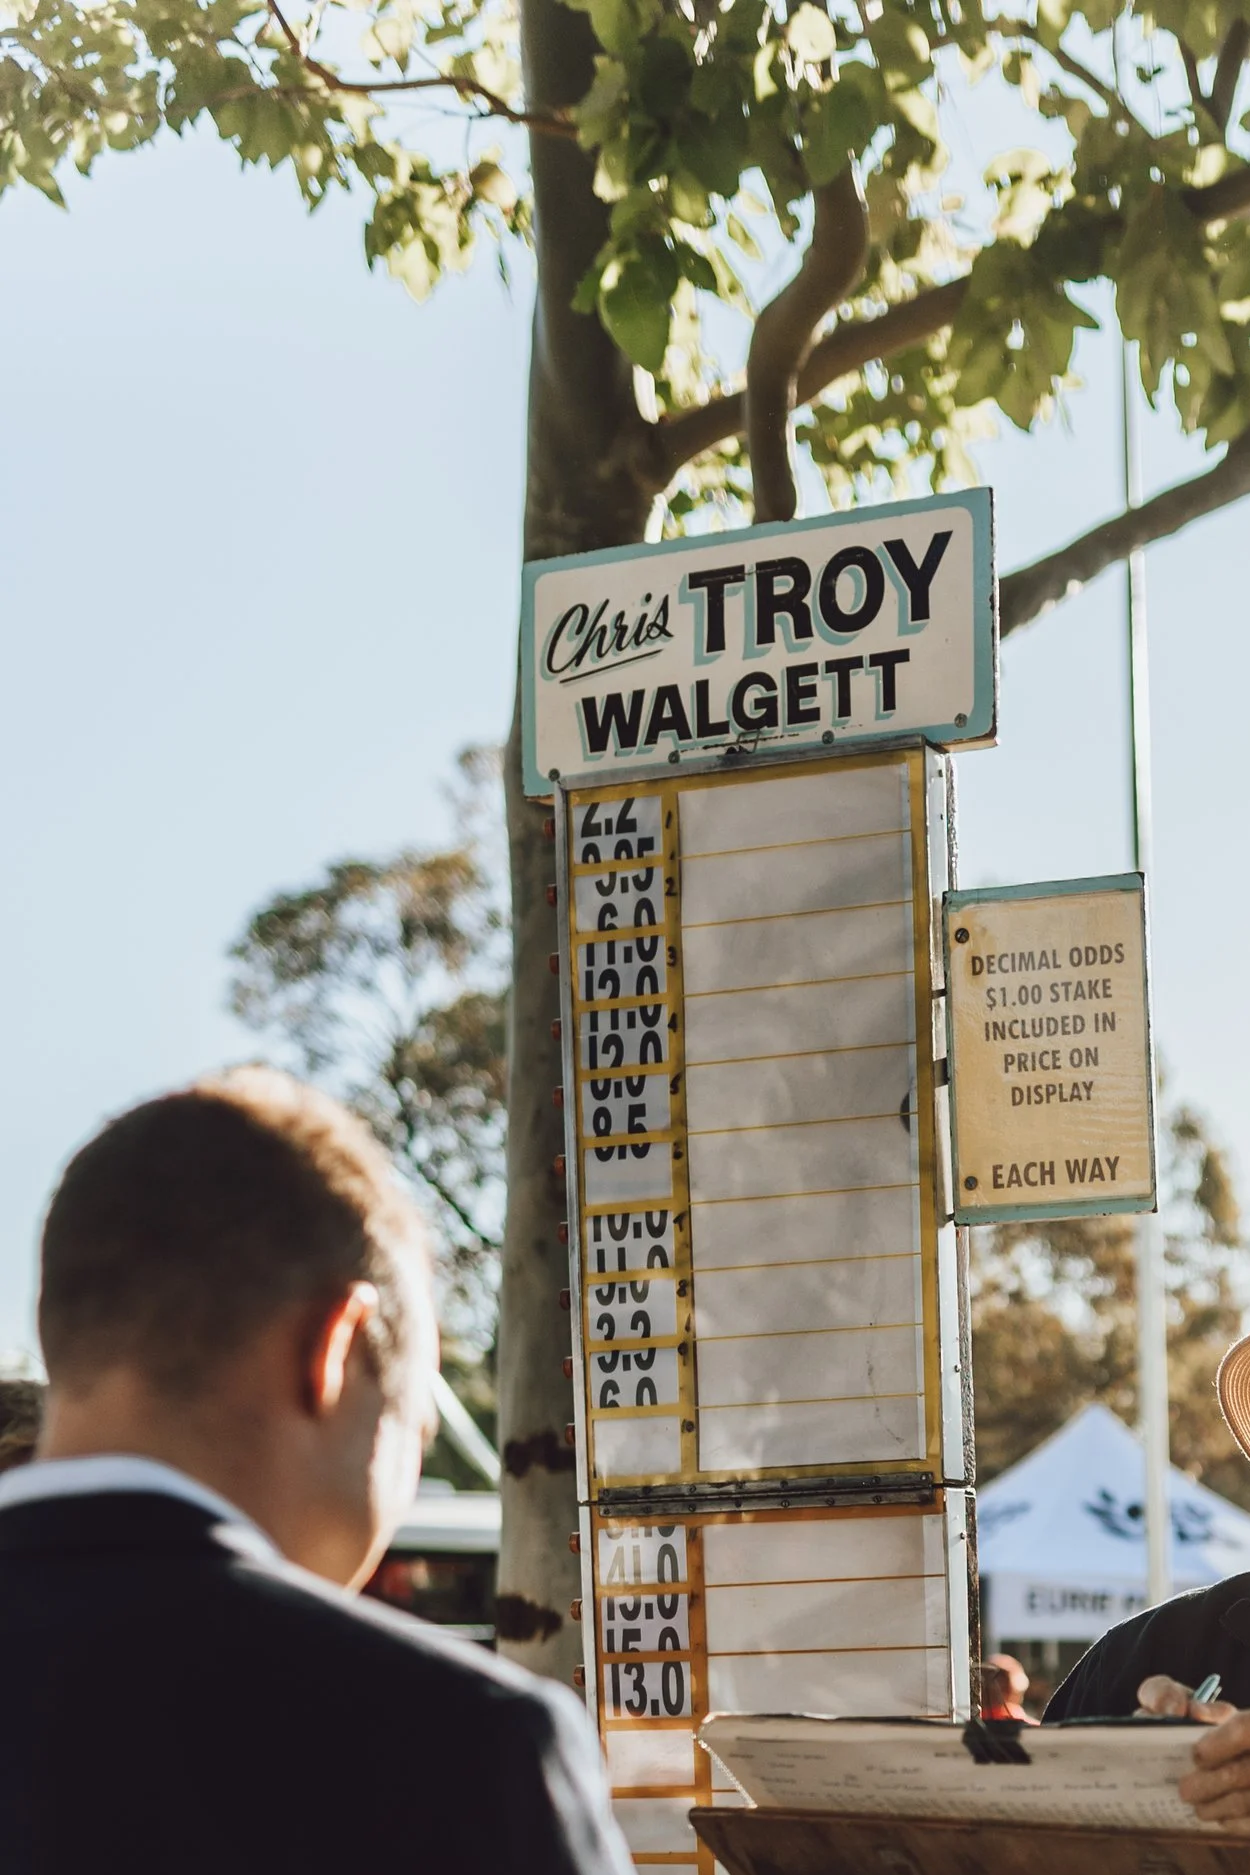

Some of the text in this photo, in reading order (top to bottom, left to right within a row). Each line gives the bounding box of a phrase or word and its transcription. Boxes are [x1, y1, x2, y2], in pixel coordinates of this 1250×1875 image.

[546, 529, 954, 675] Chris TROY
[580, 648, 911, 754] WALGETT
[971, 942, 1126, 977] DECIMAL ODDS
[985, 977, 1113, 1011] $1.00 STAKE
[984, 1011, 1117, 1042] INCLUDED IN
[1003, 1046, 1099, 1074] PRICE ON
[1011, 1080, 1094, 1107] DISPLAY
[991, 1155, 1121, 1190] EACH WAY
[611, 1660, 685, 1717] 13.0
